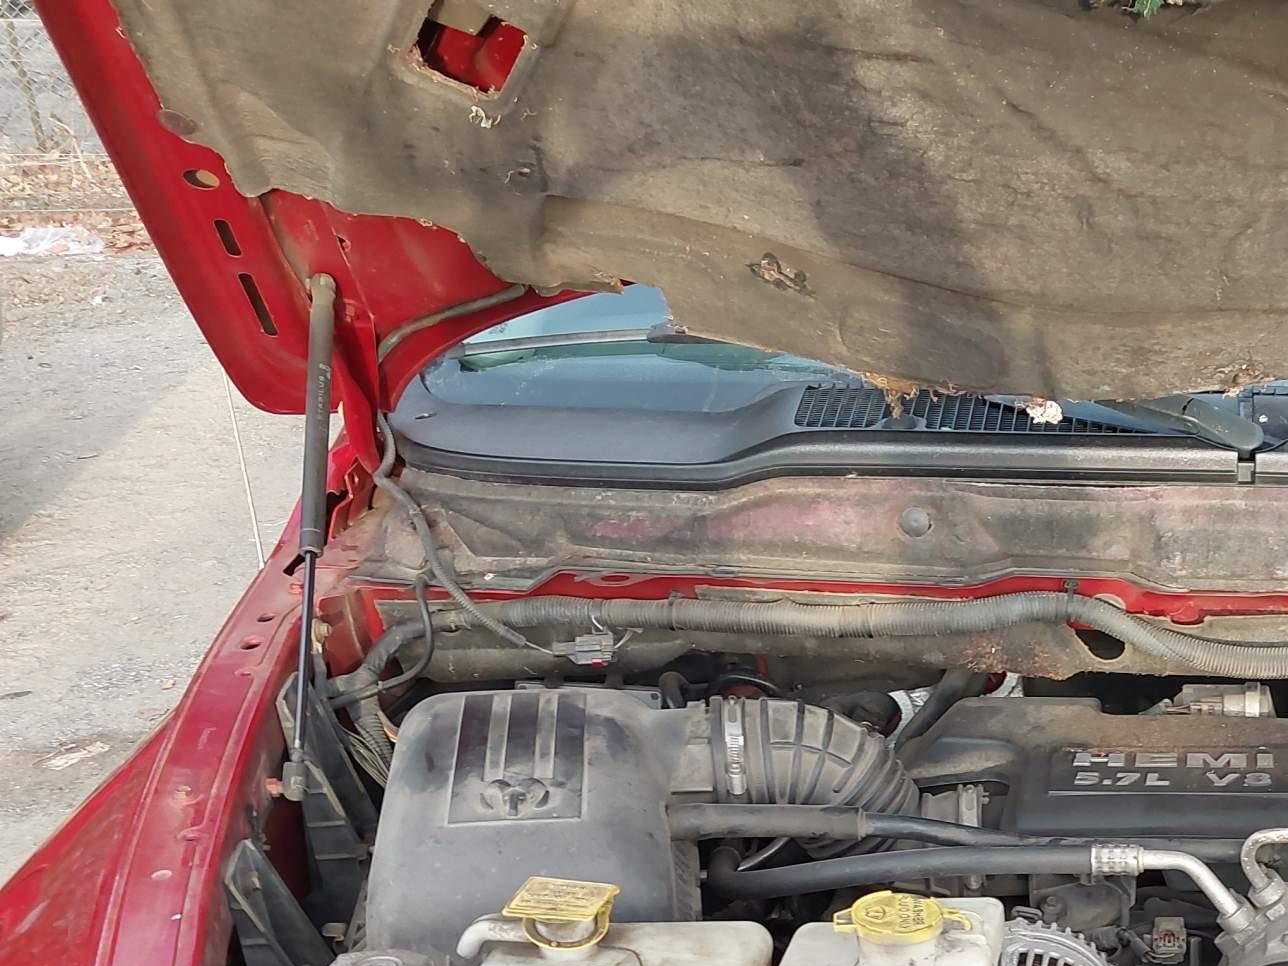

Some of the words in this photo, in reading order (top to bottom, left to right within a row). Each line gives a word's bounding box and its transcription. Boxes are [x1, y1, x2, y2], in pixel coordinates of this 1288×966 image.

[1073, 752, 1274, 768] HEMI
[1074, 772, 1171, 786] 5.7L
[1206, 771, 1273, 787] V8
